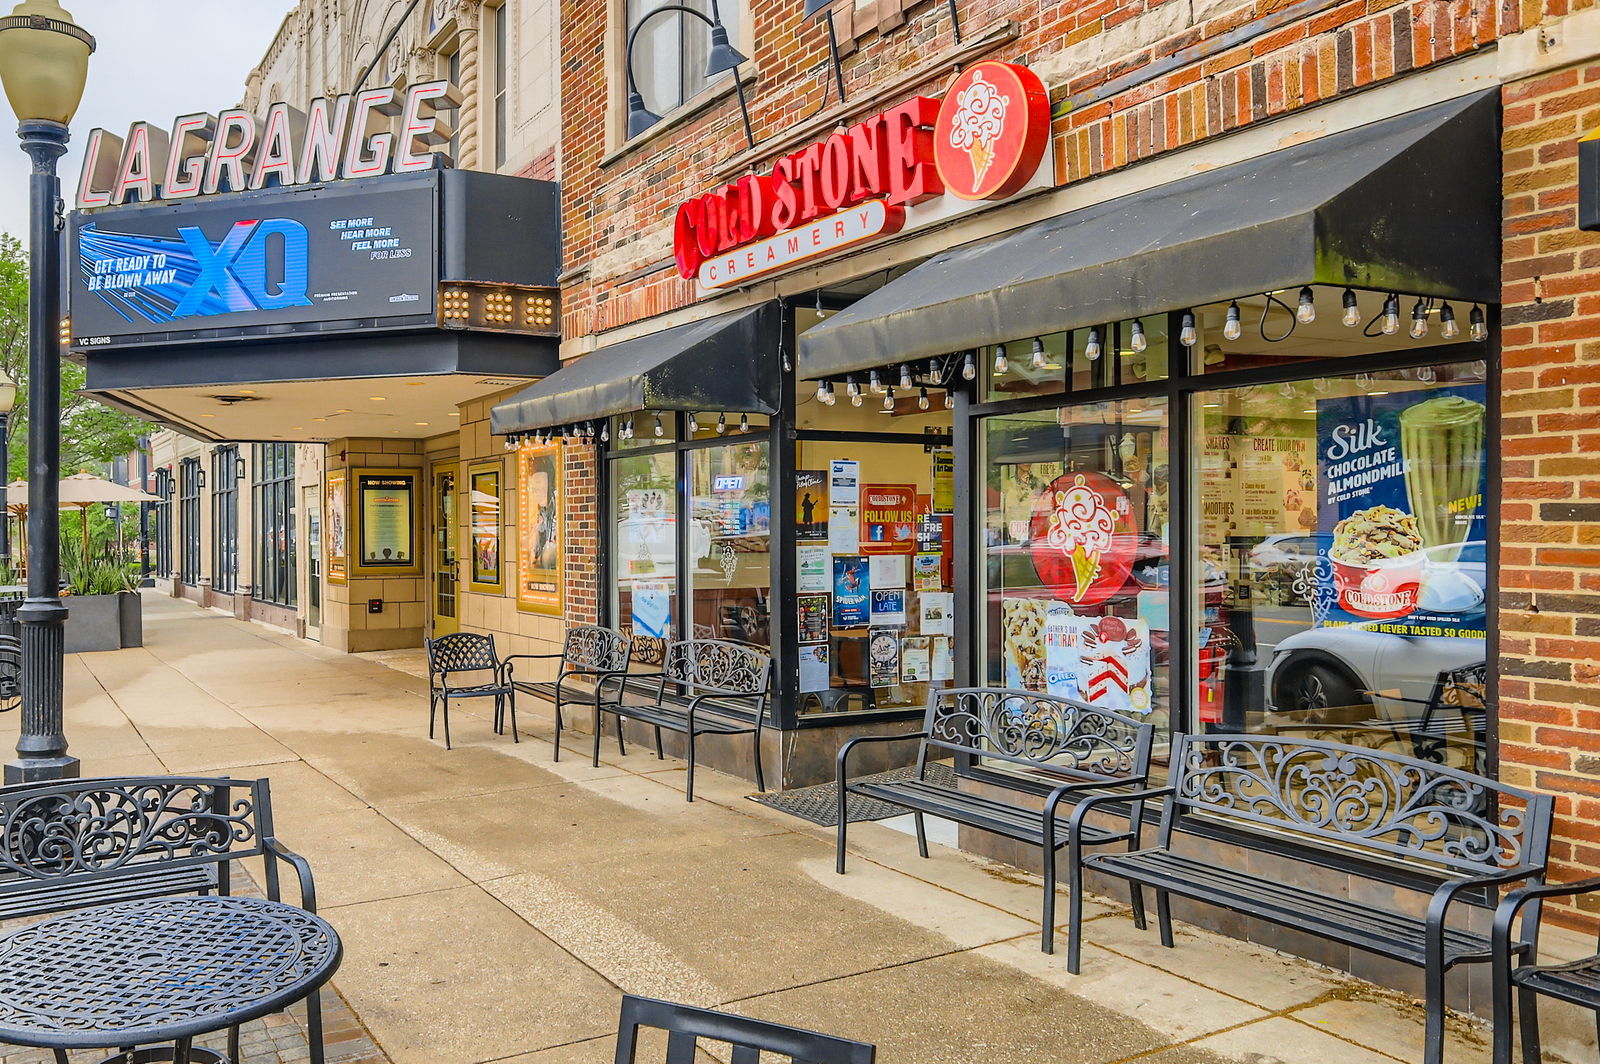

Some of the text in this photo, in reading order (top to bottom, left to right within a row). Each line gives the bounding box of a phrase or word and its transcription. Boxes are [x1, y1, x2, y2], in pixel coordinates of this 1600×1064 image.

[76, 79, 452, 208] LAGRANGE
[673, 96, 922, 280] COLD STONE
[329, 217, 374, 230] SEE MORE
[340, 227, 392, 241] HEAR MORE
[351, 238, 400, 251] FEEL MORE
[709, 210, 869, 280] CREAMERY
[370, 248, 412, 260] FOR LESS
[94, 253, 167, 274] GET READY TO
[171, 218, 314, 317] XQ
[88, 269, 177, 291] BE BLOWN AWAY
[78, 336, 111, 345] VC SIGNS
[1253, 438, 1275, 451] CREATE
[1276, 439, 1291, 452] YOUR
[1327, 418, 1388, 460] Silk
[1327, 447, 1396, 479] CHOCOLATE
[715, 476, 743, 490] OPEN
[1327, 459, 1412, 496] ALMONDMILK
[1327, 496, 1337, 505] BY
[1337, 492, 1351, 502] COLD
[1448, 493, 1482, 514] NEW!
[1203, 502, 1234, 515] MOOTHIES
[864, 510, 912, 523] FOLLOW US
[917, 513, 930, 523] RE
[924, 523, 943, 532] FRE
[916, 532, 930, 542] SH
[875, 591, 900, 602] OPEN
[1345, 590, 1411, 606] COLD STONE
[879, 601, 897, 611] LATE
[1047, 625, 1068, 633] FATHER'S
[1380, 623, 1408, 635] NEVER
[1410, 625, 1442, 636] TASTED
[1444, 628, 1456, 637] SO
[1458, 629, 1487, 640] GOOD!
[1048, 633, 1078, 648] HOORAY!
[1048, 671, 1076, 685] OREO
